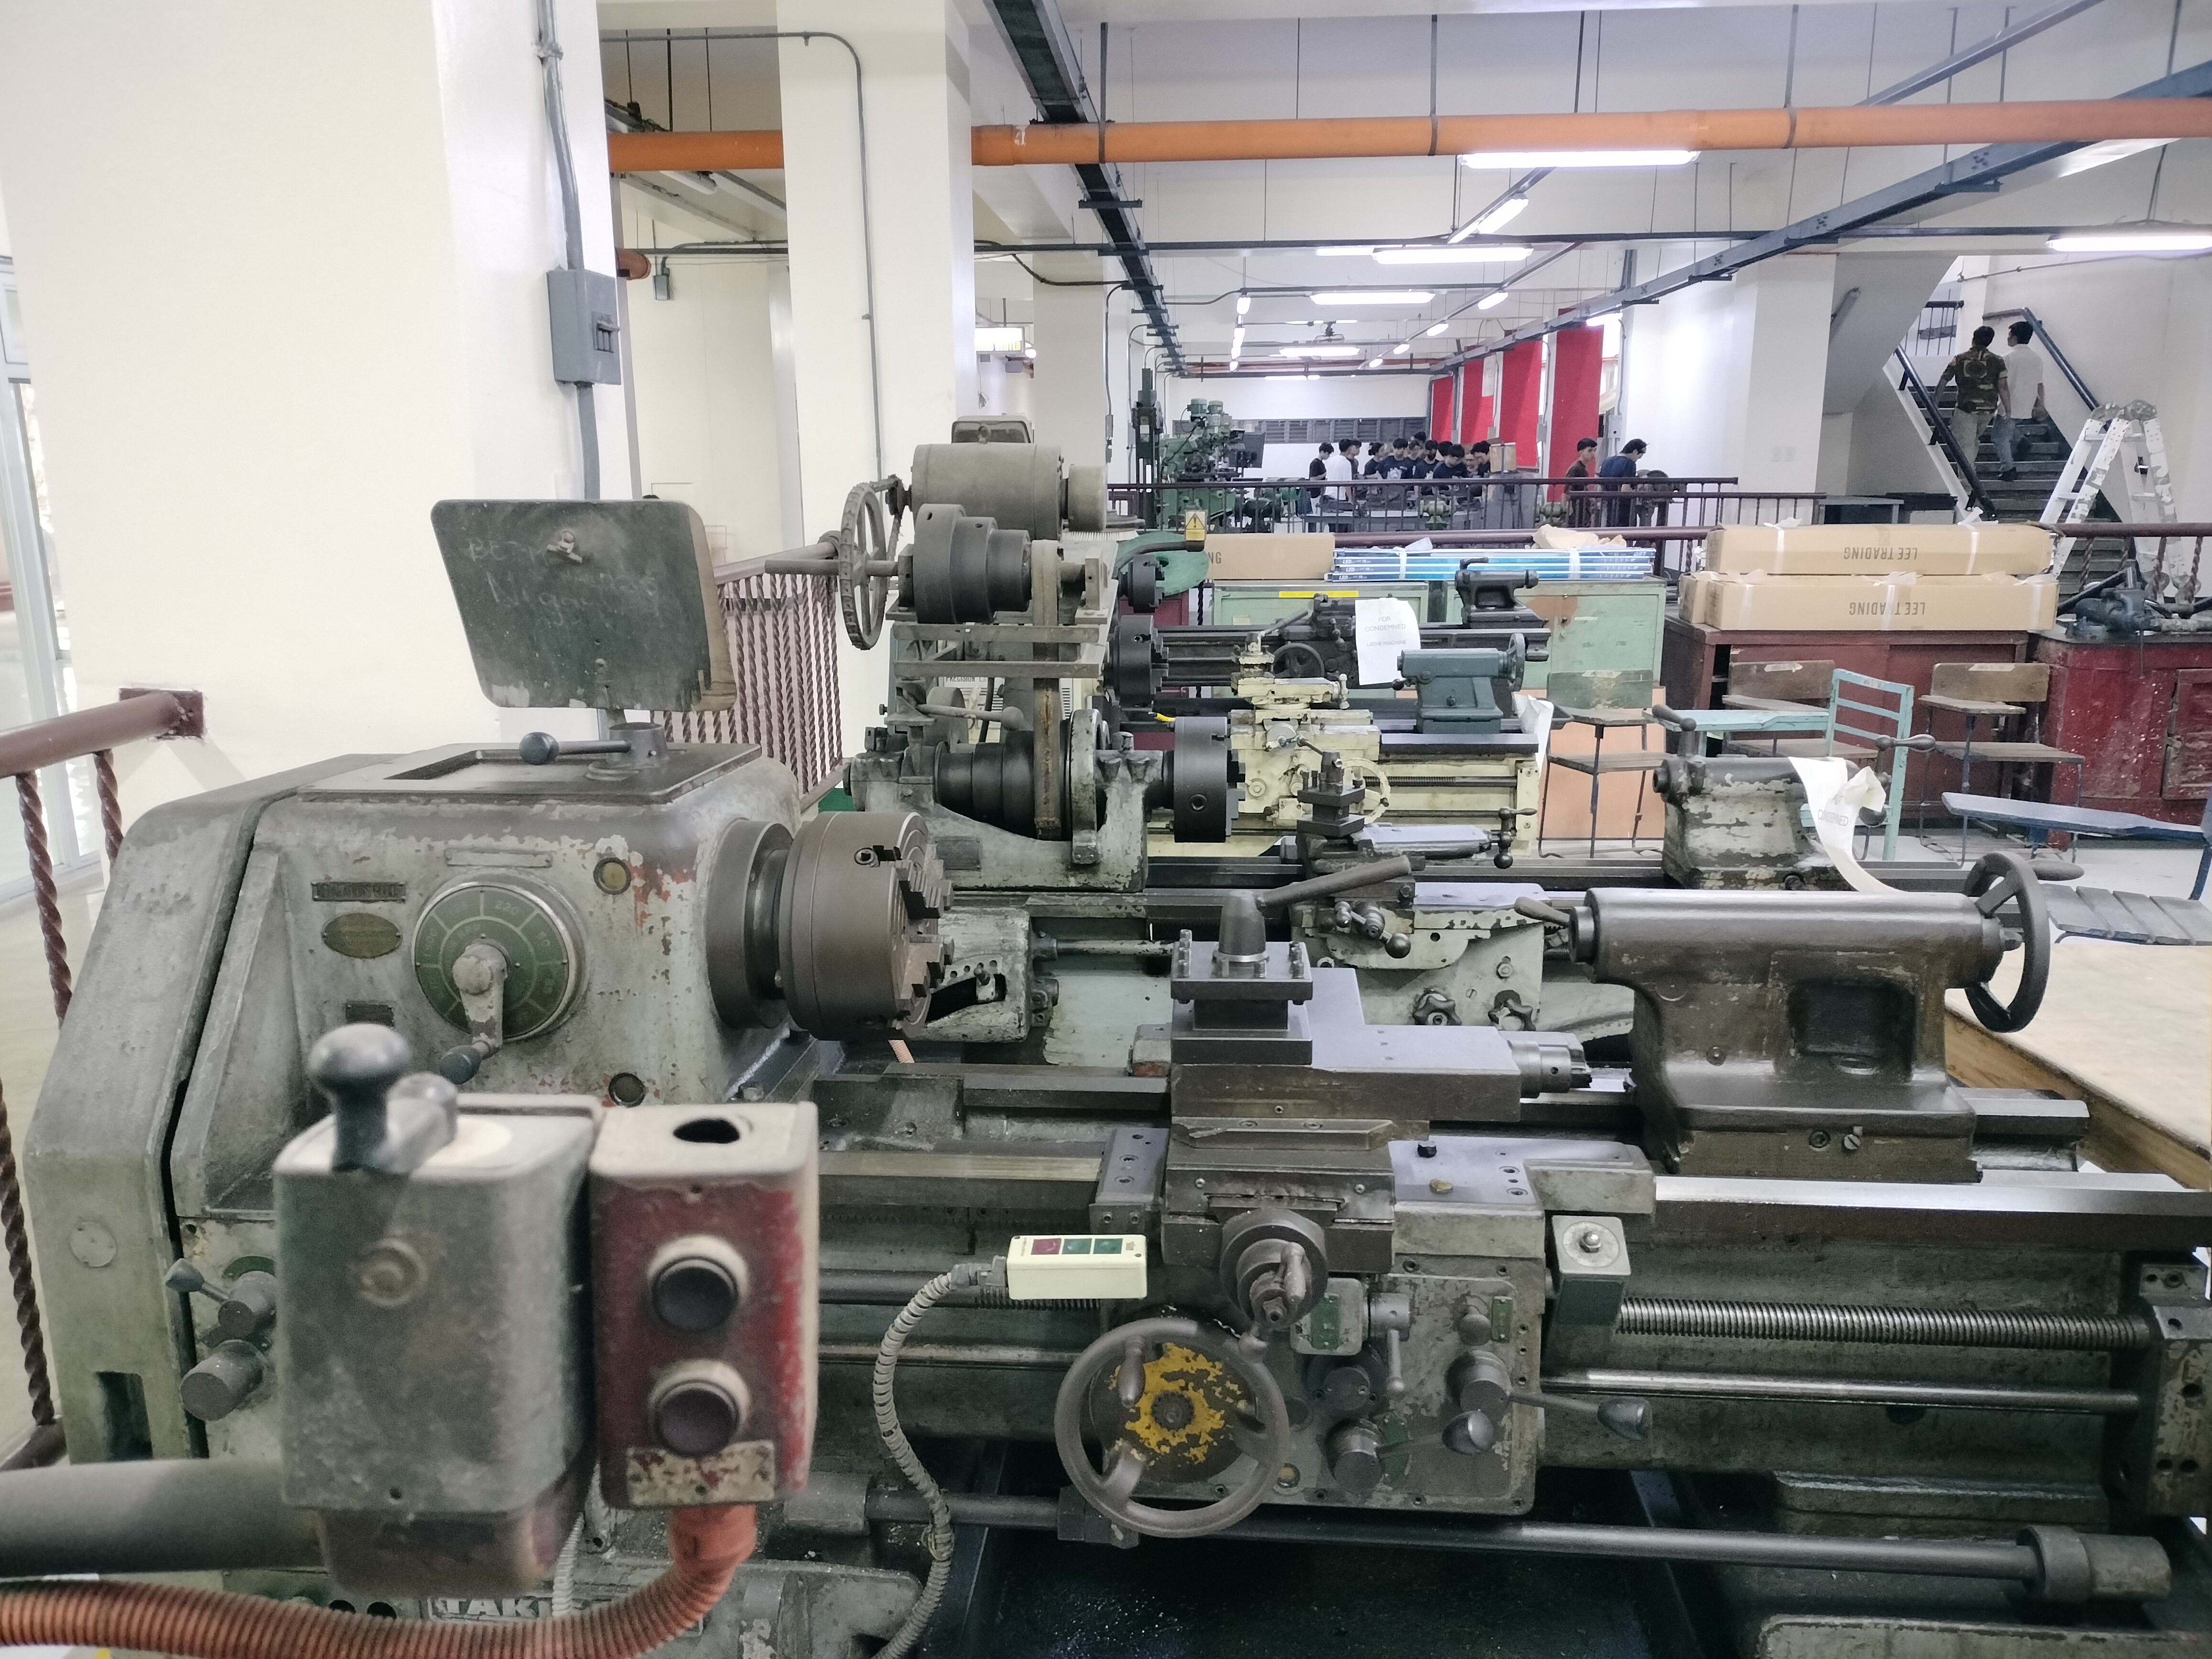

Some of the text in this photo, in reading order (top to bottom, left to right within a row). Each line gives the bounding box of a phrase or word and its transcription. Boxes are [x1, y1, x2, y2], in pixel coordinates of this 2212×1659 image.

[1844, 547, 1918, 560] LEE TRADING
[1849, 602, 1925, 615] LEE TADING
[1365, 624, 1406, 632] CONDEMNED
